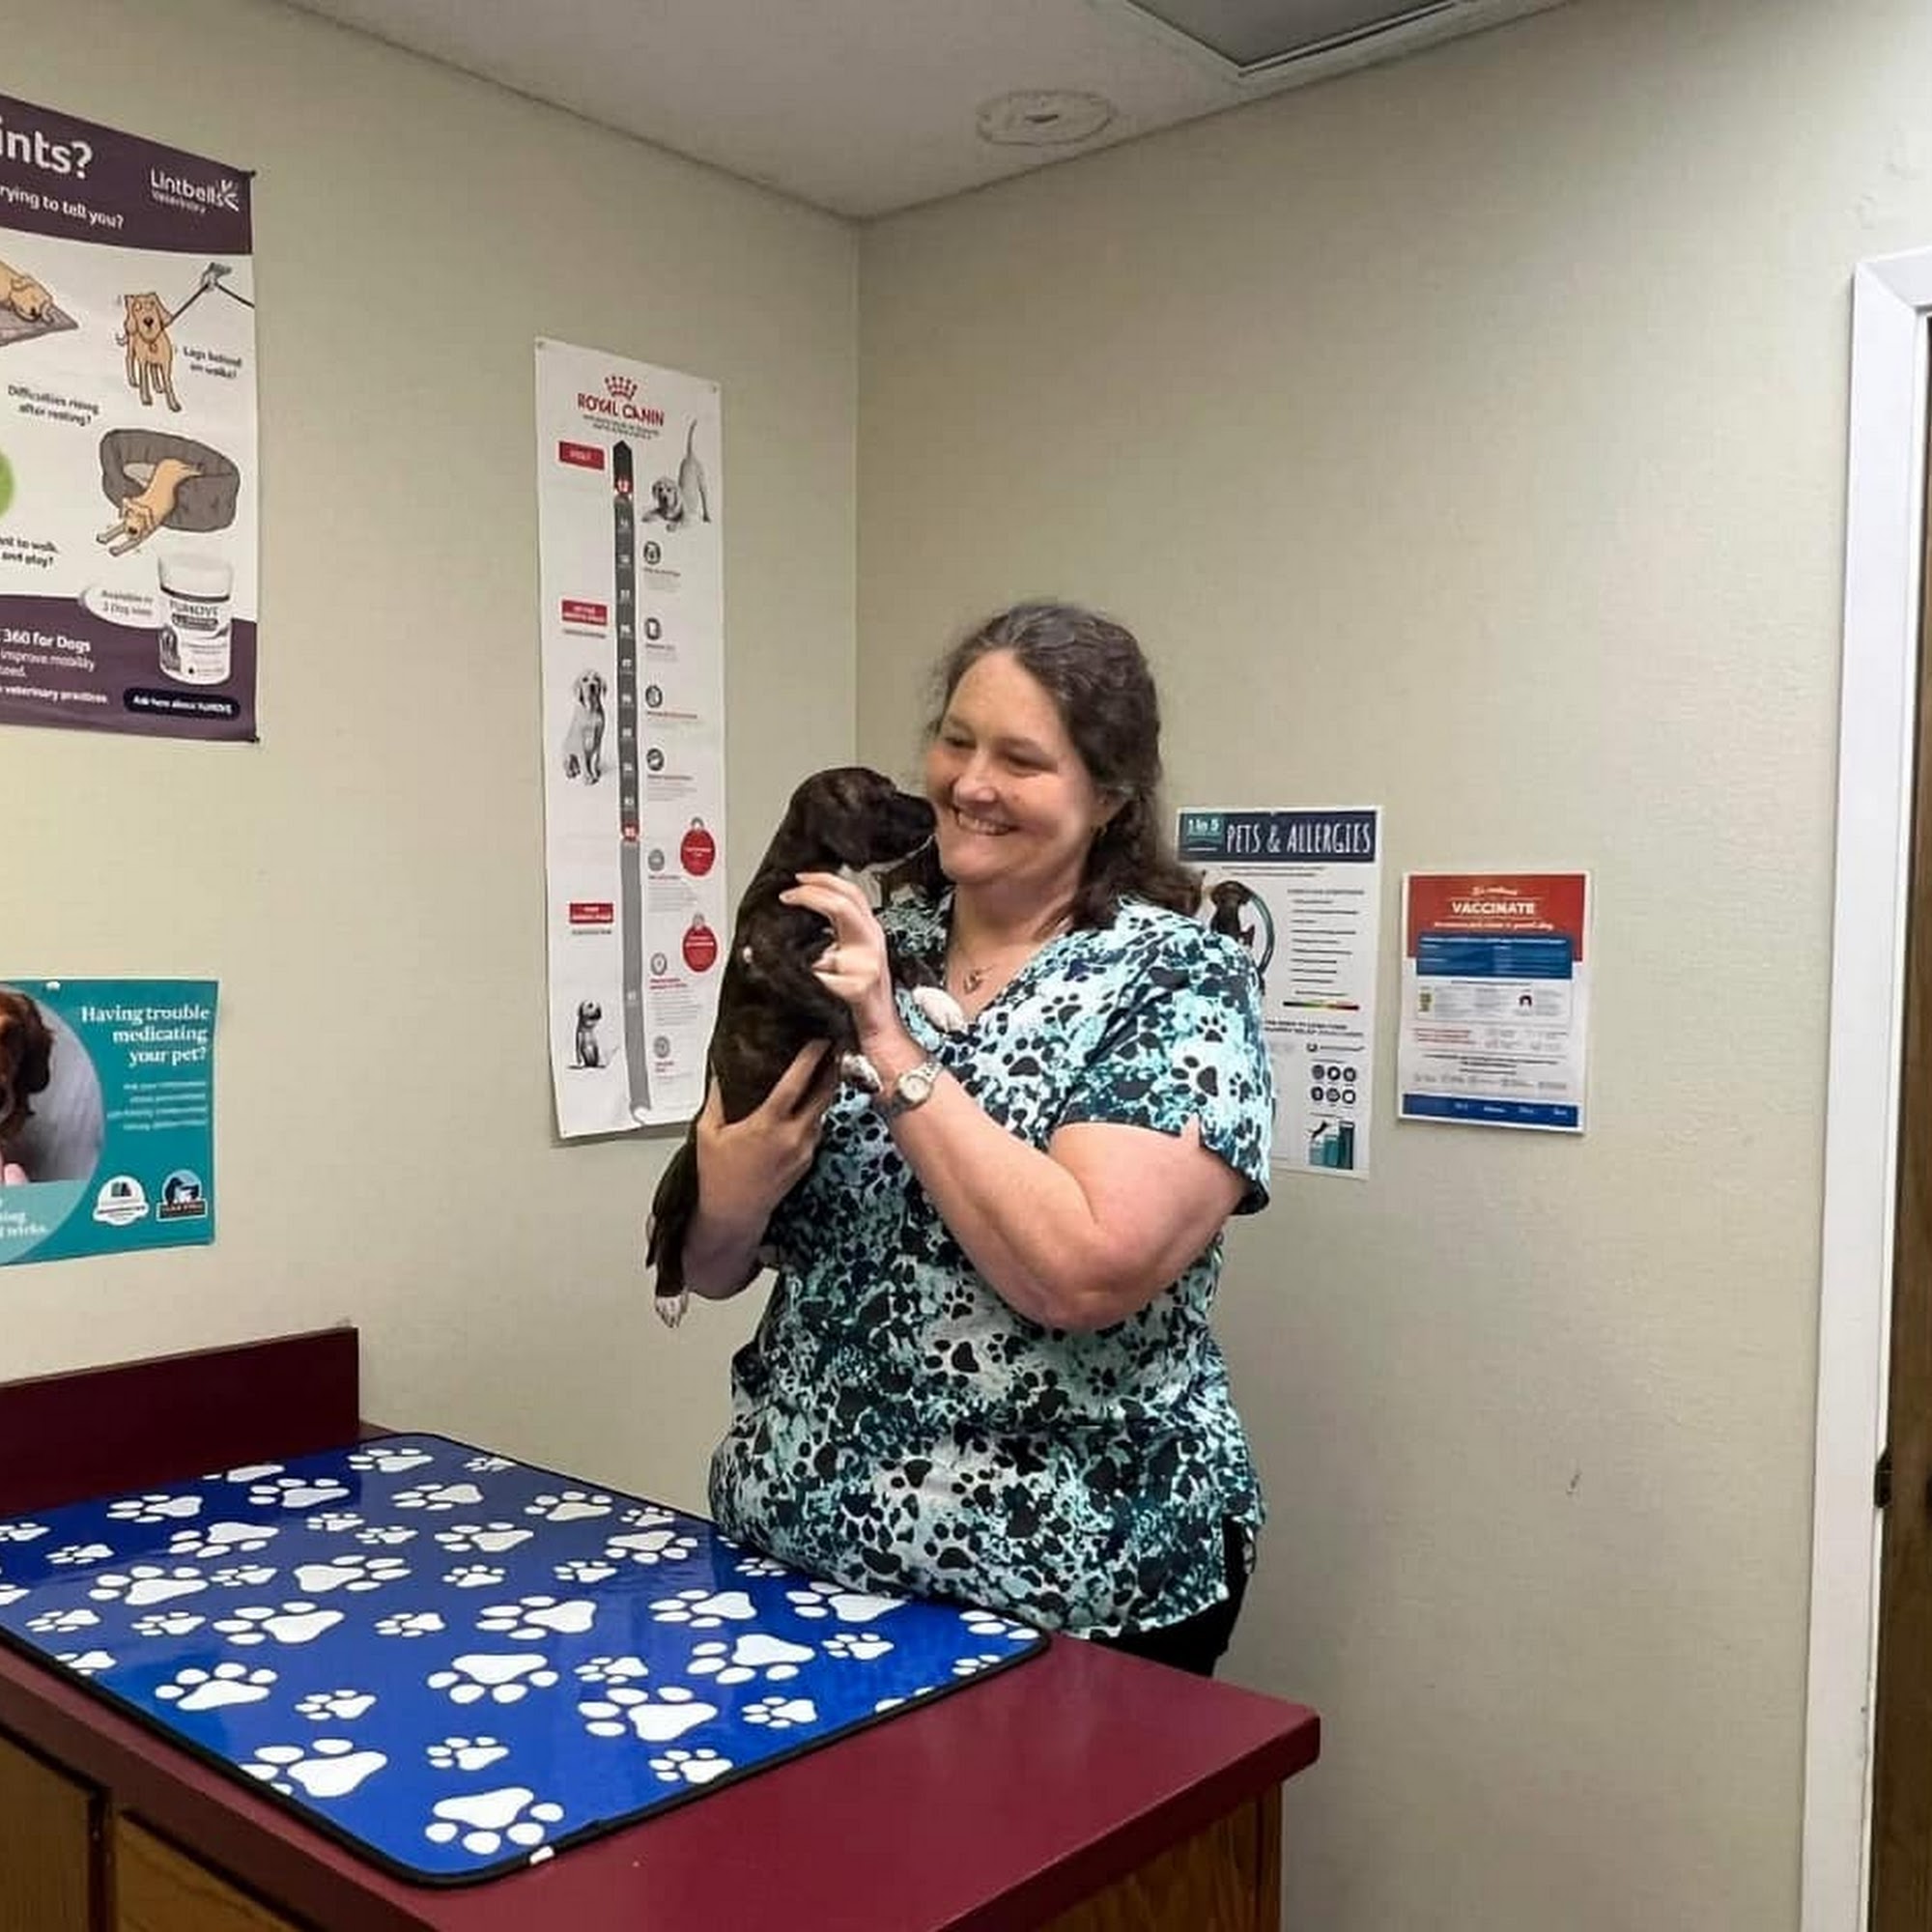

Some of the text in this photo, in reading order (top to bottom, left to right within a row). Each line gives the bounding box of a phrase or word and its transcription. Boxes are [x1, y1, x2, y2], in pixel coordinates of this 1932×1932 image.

[42, 195, 59, 212] to
[62, 200, 88, 219] tell
[88, 210, 125, 230] you?
[577, 392, 618, 417] ROYAL
[622, 403, 665, 428] CANIN
[17, 537, 29, 550] to
[3, 628, 91, 654] 360 for Dogs
[1209, 818, 1219, 831] 5
[1226, 822, 1372, 855] PETS & ALLERGIES
[1451, 901, 1534, 916] VACCINATE
[82, 1004, 211, 1026] Having trouble
[112, 1024, 209, 1044] medicating
[128, 1045, 207, 1069] your pet?
